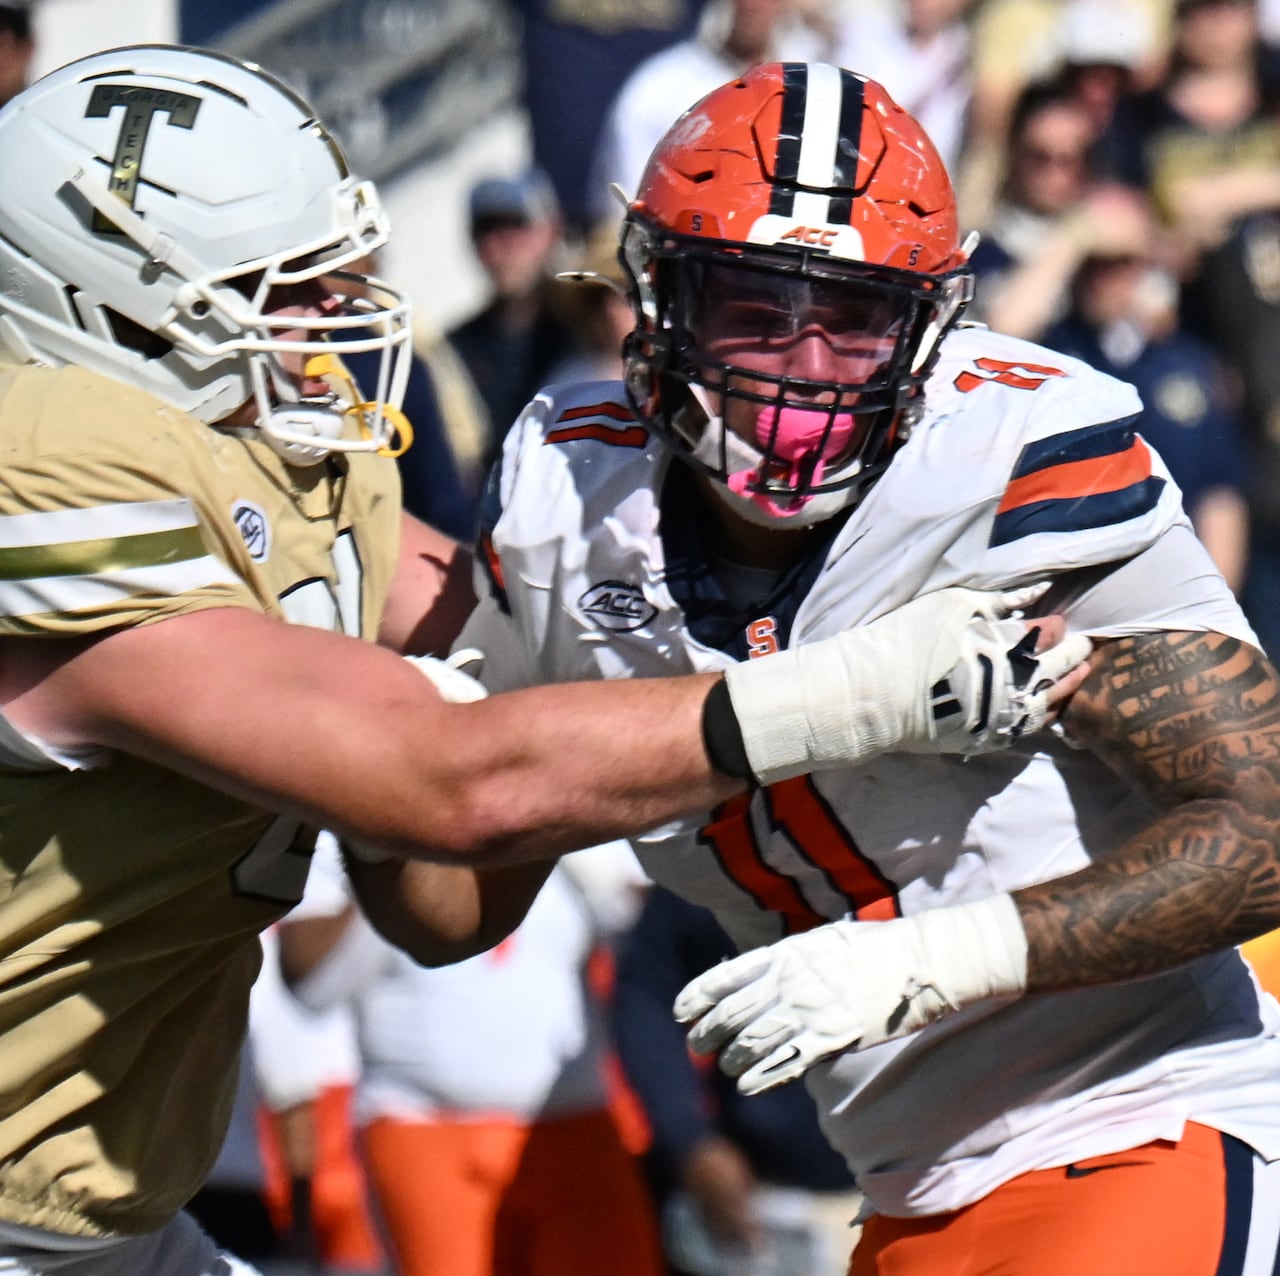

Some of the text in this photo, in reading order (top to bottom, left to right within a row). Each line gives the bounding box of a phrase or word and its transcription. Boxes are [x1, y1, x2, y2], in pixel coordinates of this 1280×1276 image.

[116, 114, 143, 191] TECH
[781, 225, 839, 247] ACC
[588, 592, 645, 615] ACC
[746, 616, 781, 659] S
